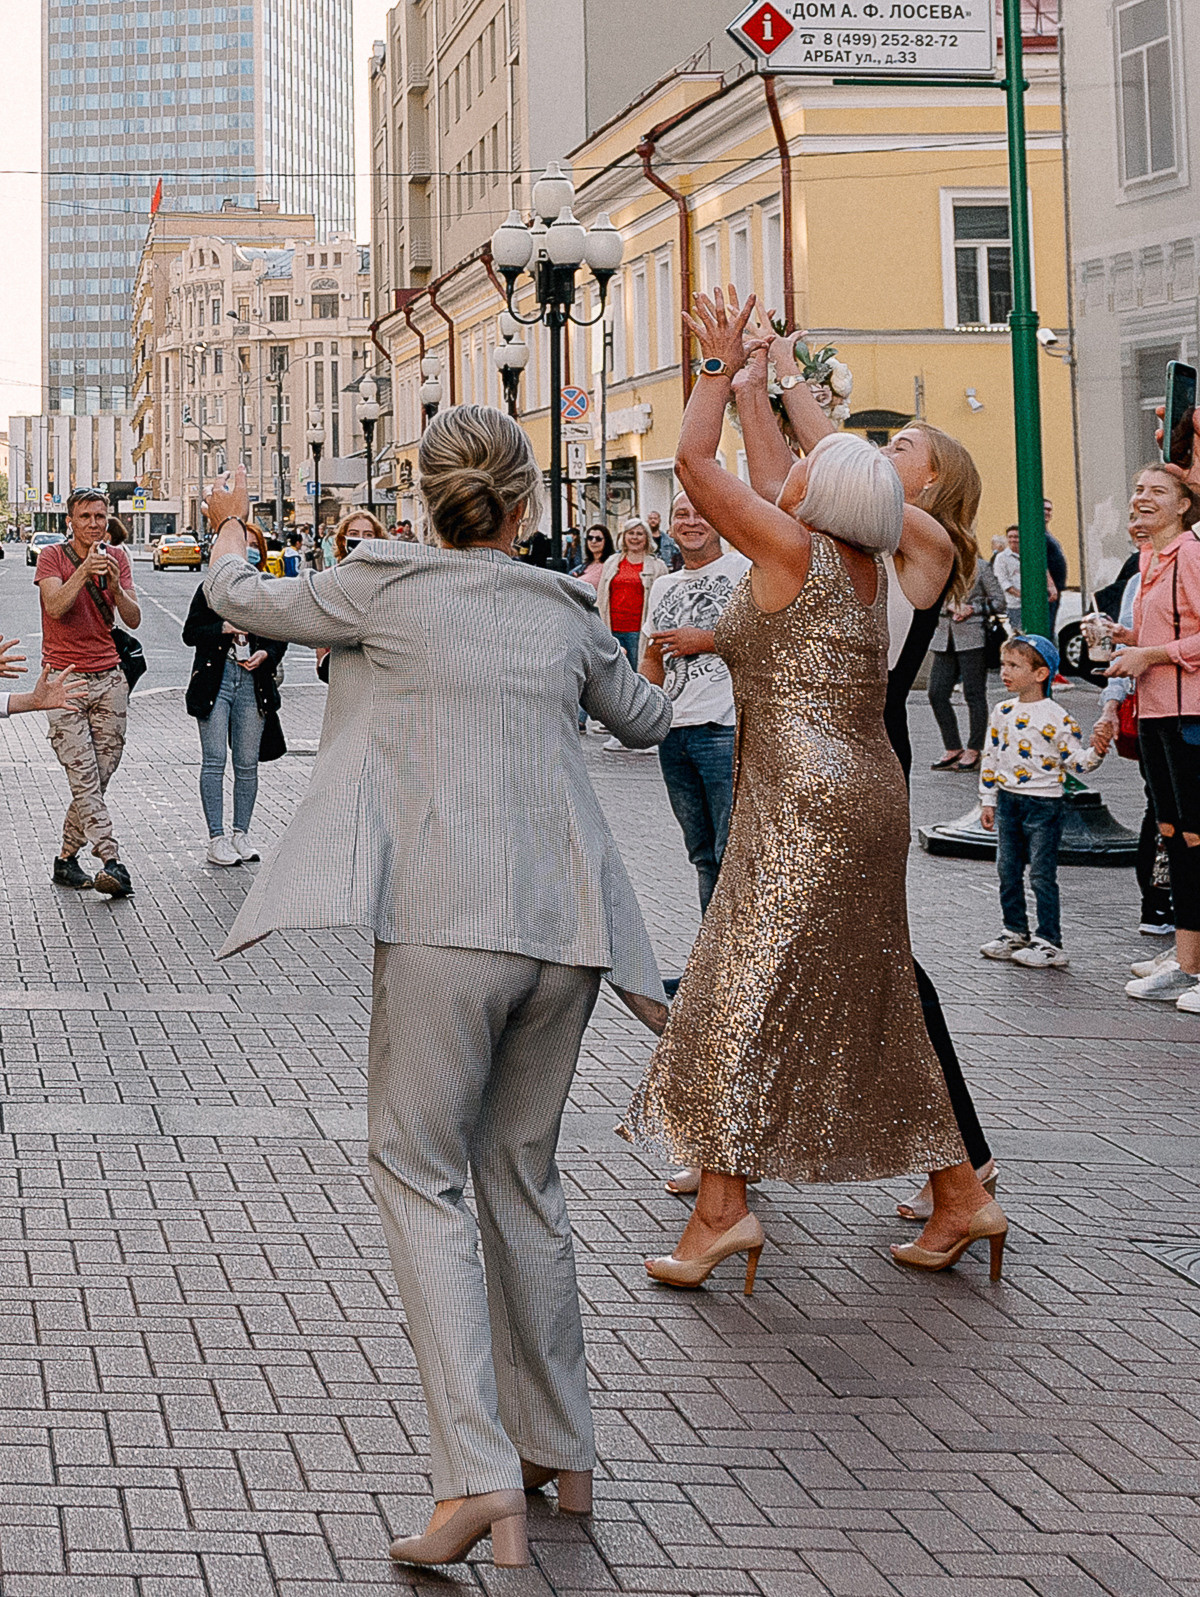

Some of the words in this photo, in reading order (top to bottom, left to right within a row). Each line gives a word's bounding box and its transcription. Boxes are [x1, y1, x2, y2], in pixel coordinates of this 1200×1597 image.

[841, 4, 858, 18] А.
[863, 4, 884, 18] Ф.
[823, 33, 833, 45] 8
[837, 33, 877, 48] (499)
[881, 34, 959, 47] 252-82-72
[803, 50, 851, 62] АРБАТ
[572, 461, 583, 470] 70
